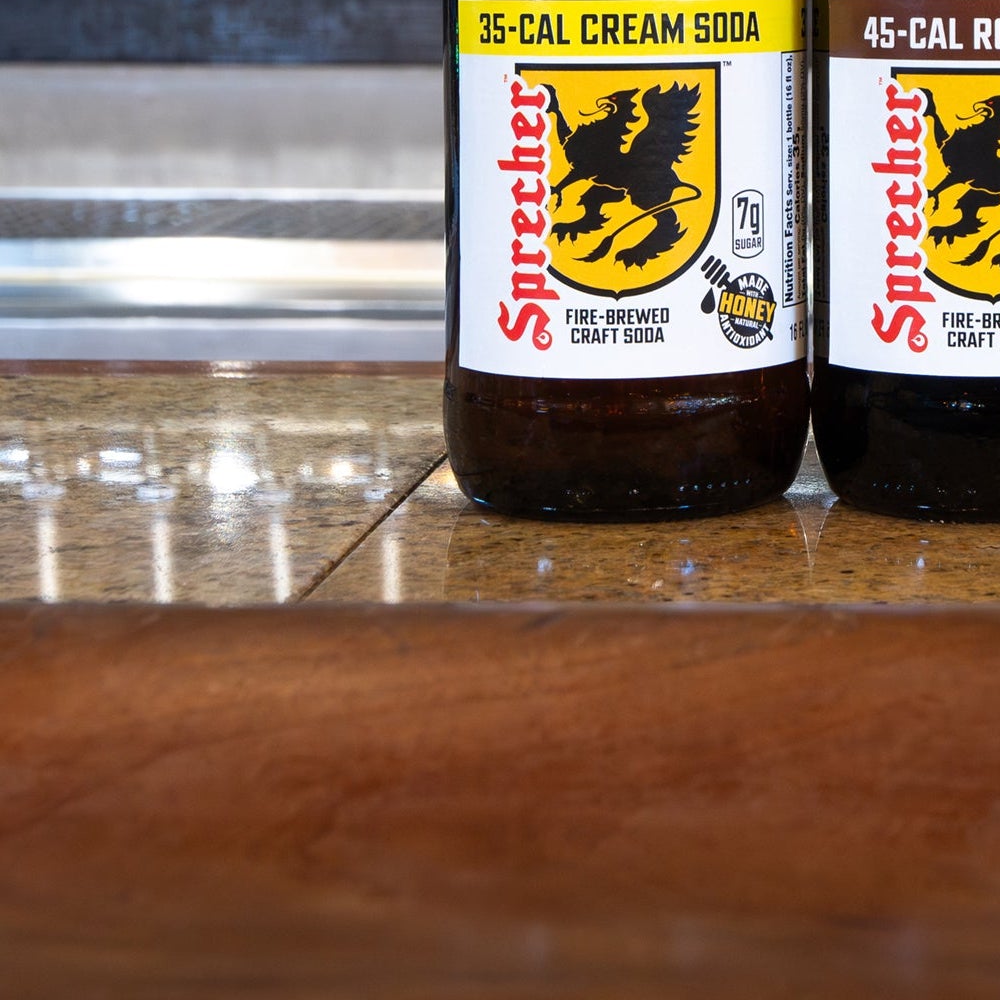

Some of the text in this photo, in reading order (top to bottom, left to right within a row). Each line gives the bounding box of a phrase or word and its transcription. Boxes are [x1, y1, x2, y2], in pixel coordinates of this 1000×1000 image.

[478, 12, 571, 45] 35-CAL
[581, 12, 685, 45] CREAM
[694, 11, 760, 43] SODA
[863, 16, 963, 50] 45-CAL
[785, 75, 792, 83] fl
[785, 85, 794, 101] (16
[497, 81, 561, 351] Sprecher
[737, 196, 760, 236] 7g
[785, 199, 793, 238] Facts
[871, 84, 936, 353] Sprecher
[735, 236, 762, 250] SUGAR
[738, 274, 770, 296] MADE
[785, 241, 793, 303] Nutrition
[565, 307, 670, 325] FIRE-BREWED
[719, 291, 777, 323] HONEY
[570, 327, 665, 345] CRAFT SODA
[719, 314, 770, 347] ANTIOXIDANT
[947, 331, 997, 348] CRAFT
